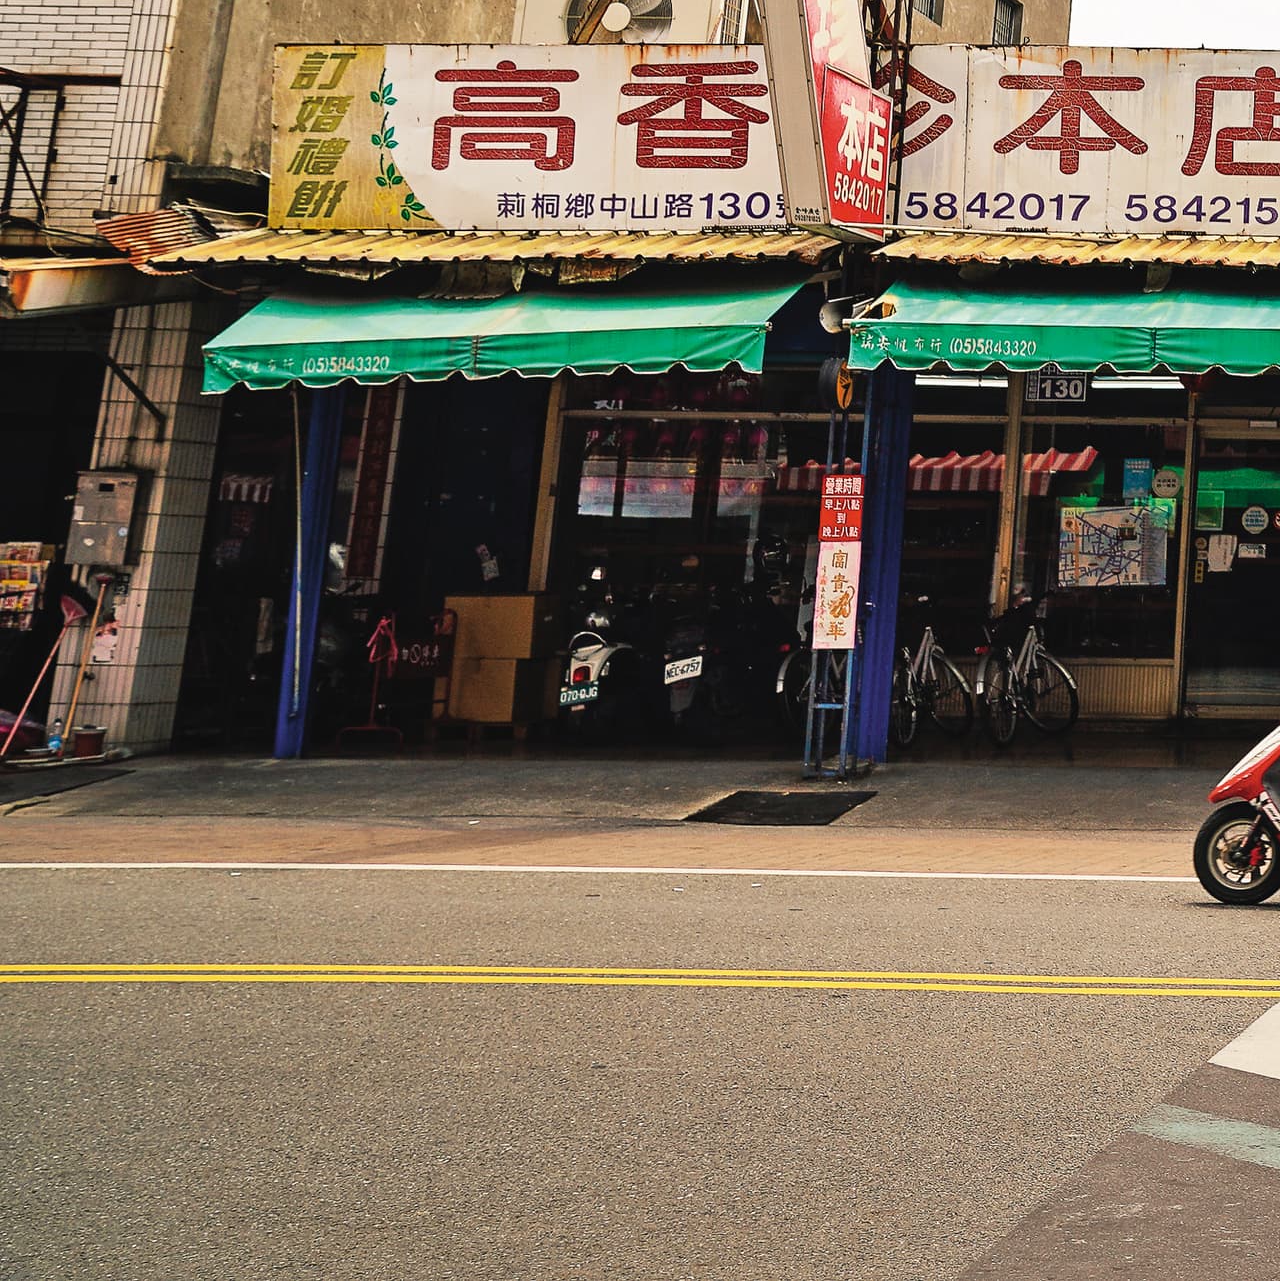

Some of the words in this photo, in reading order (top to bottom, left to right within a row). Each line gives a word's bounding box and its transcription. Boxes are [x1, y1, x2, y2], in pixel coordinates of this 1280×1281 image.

[288, 50, 358, 220] 訂婚禮餅
[836, 96, 887, 182] 本店
[833, 171, 884, 216] 5842017
[905, 191, 1091, 223] 5842017
[949, 337, 1037, 357] (05)5843320
[302, 355, 390, 374] (05)5843320
[1041, 378, 1083, 399] 130
[824, 477, 863, 495] 營業時間
[824, 499, 861, 512] 早上八點
[836, 512, 847, 525] 到
[822, 526, 859, 538] 晚上八點
